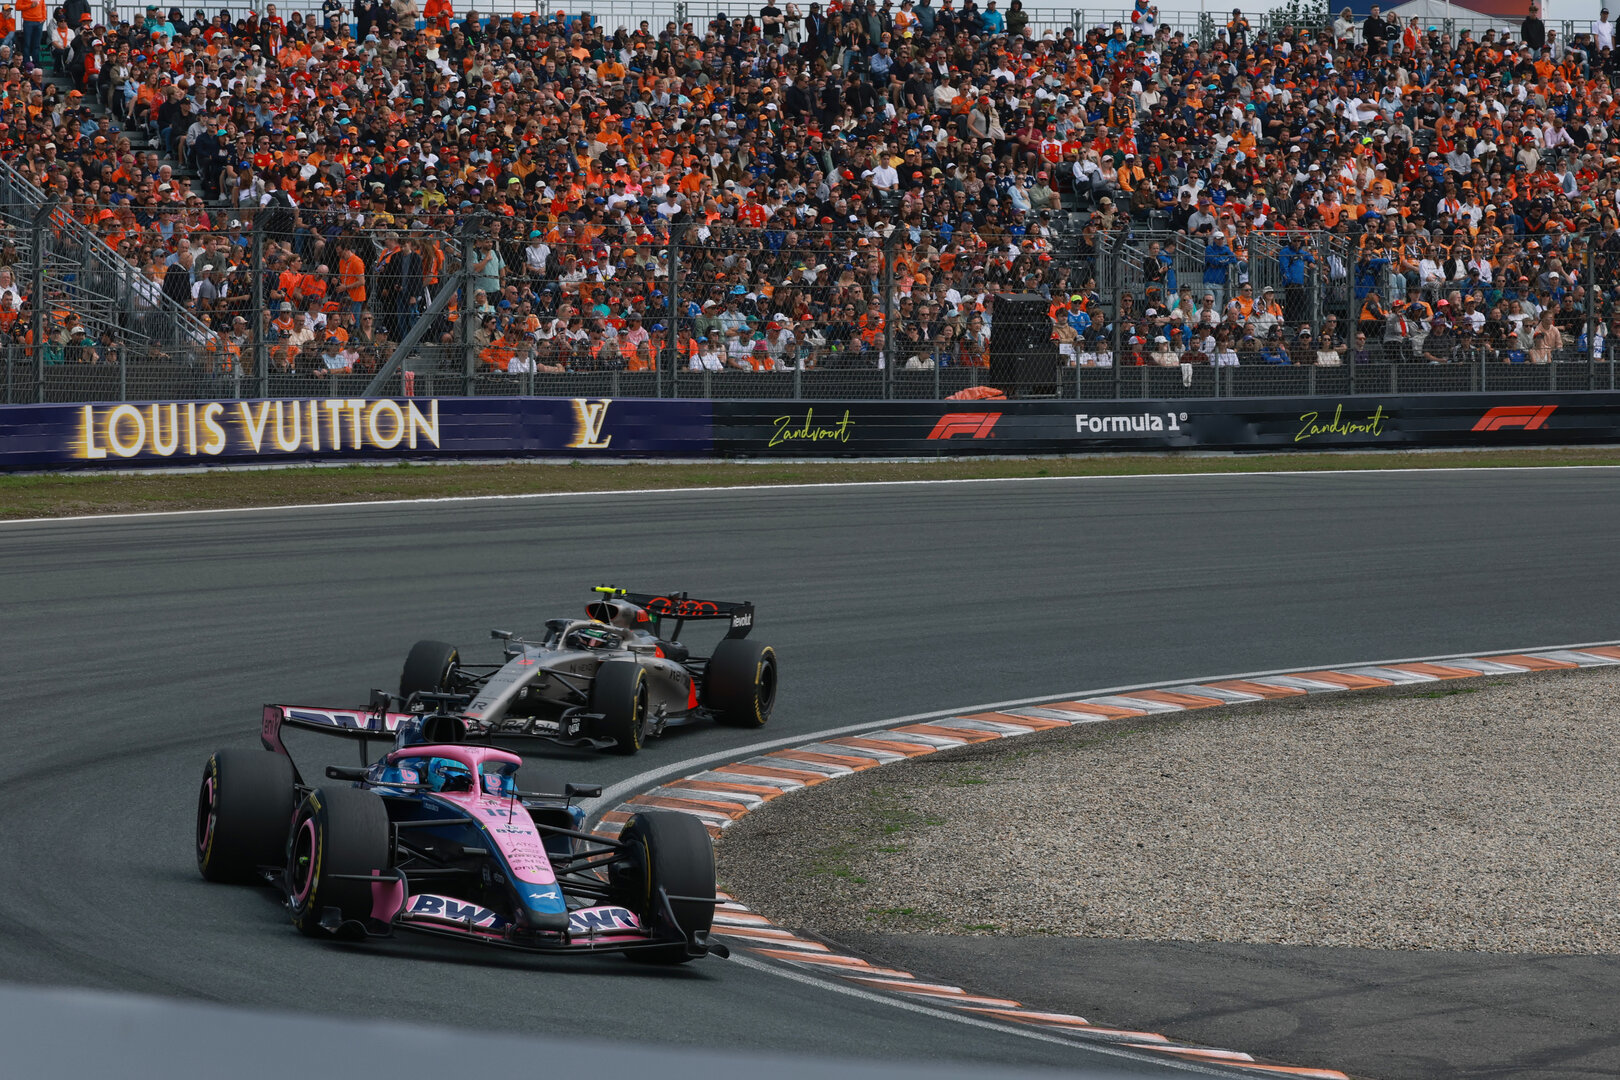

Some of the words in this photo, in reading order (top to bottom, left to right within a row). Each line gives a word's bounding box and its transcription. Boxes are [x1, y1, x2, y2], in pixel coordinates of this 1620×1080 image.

[82, 402, 227, 460] LOUIS
[239, 398, 441, 454] VUITTON
[768, 408, 856, 448] Zandvoort
[927, 412, 1002, 441] F1
[1075, 413, 1164, 433] Formula
[1294, 404, 1390, 443] Zandvoort
[1471, 404, 1559, 432] F1
